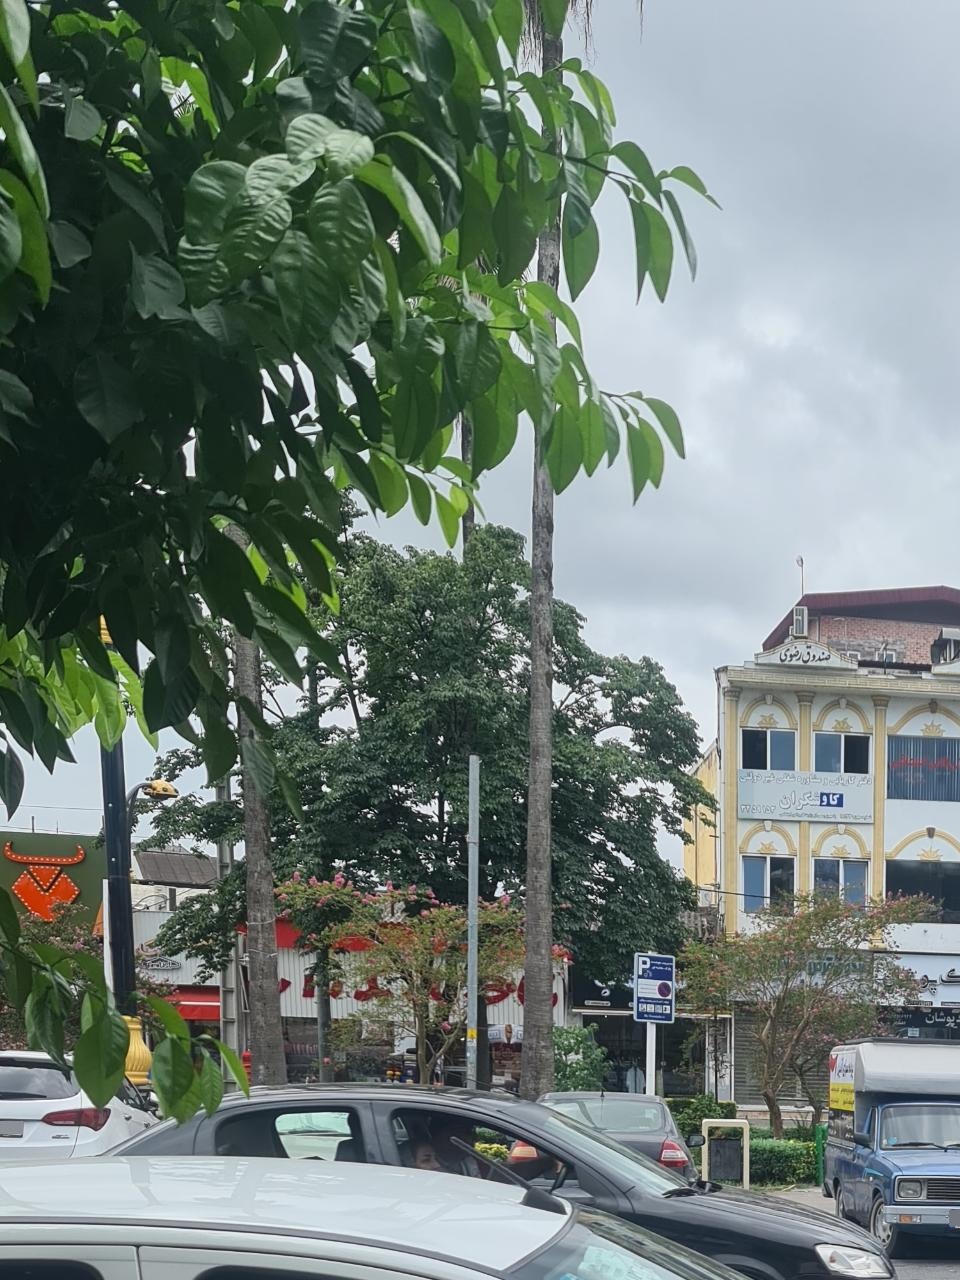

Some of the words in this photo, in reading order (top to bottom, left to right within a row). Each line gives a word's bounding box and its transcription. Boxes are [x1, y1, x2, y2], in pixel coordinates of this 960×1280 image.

[780, 646, 802, 663] رضوی
[802, 646, 831, 664] صندوق
[638, 956, 651, 976] P
[925, 1011, 957, 1028] پوشان
